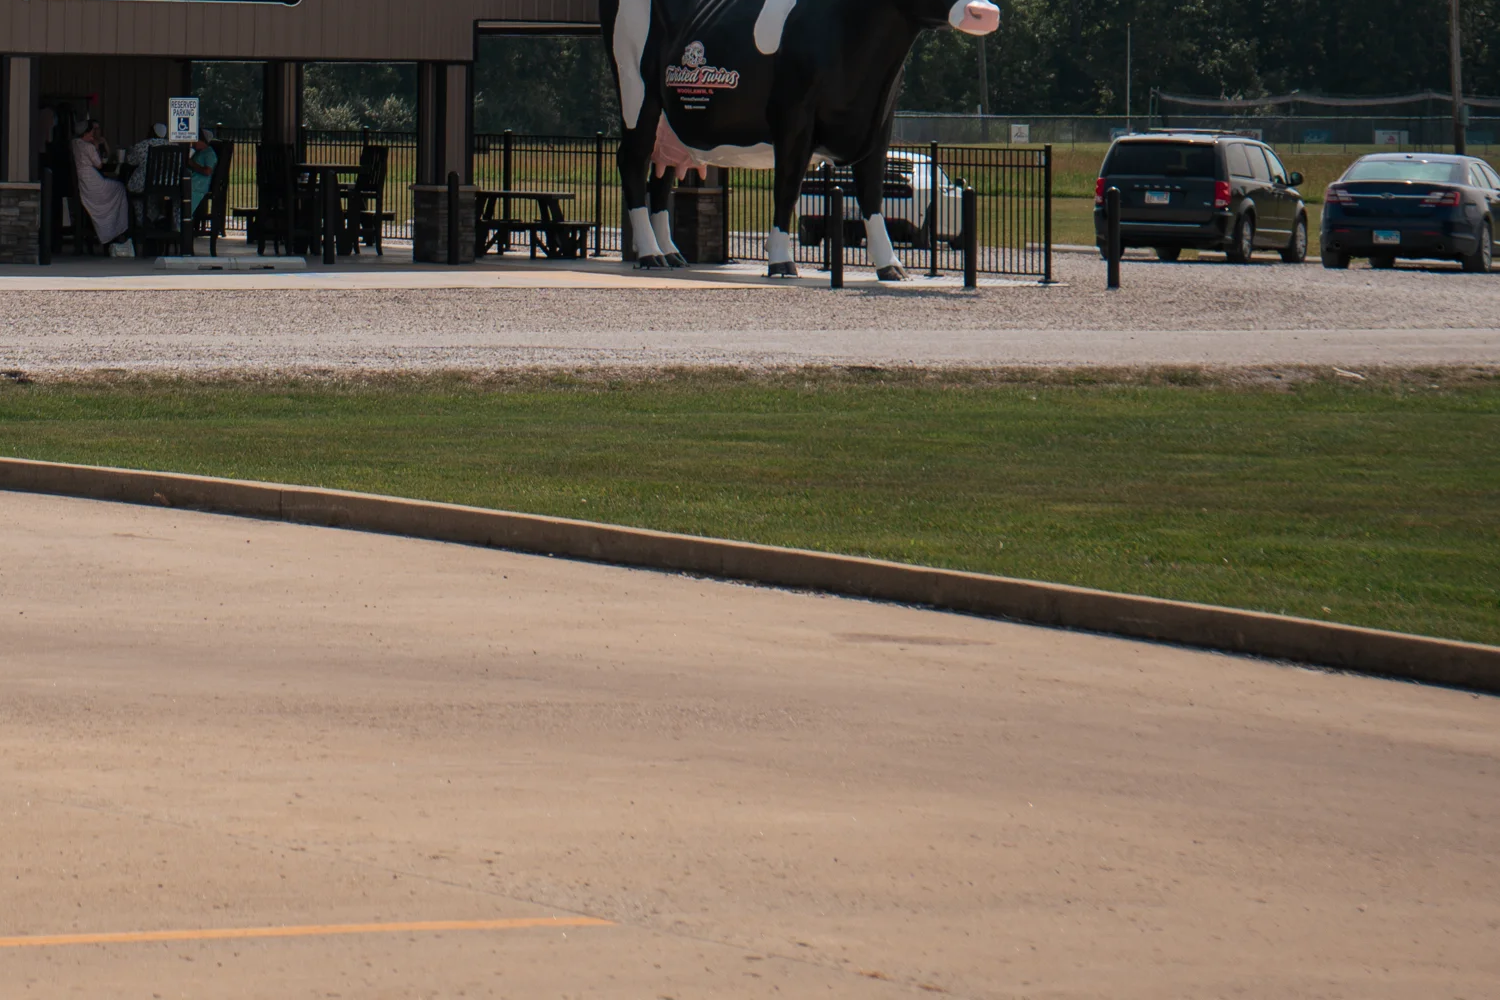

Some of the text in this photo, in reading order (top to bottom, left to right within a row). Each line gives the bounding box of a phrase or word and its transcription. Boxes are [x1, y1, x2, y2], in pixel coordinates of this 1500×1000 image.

[667, 66, 738, 85] Twisted Twins
[171, 101, 197, 109] RESERVED
[173, 109, 194, 117] PARKING
